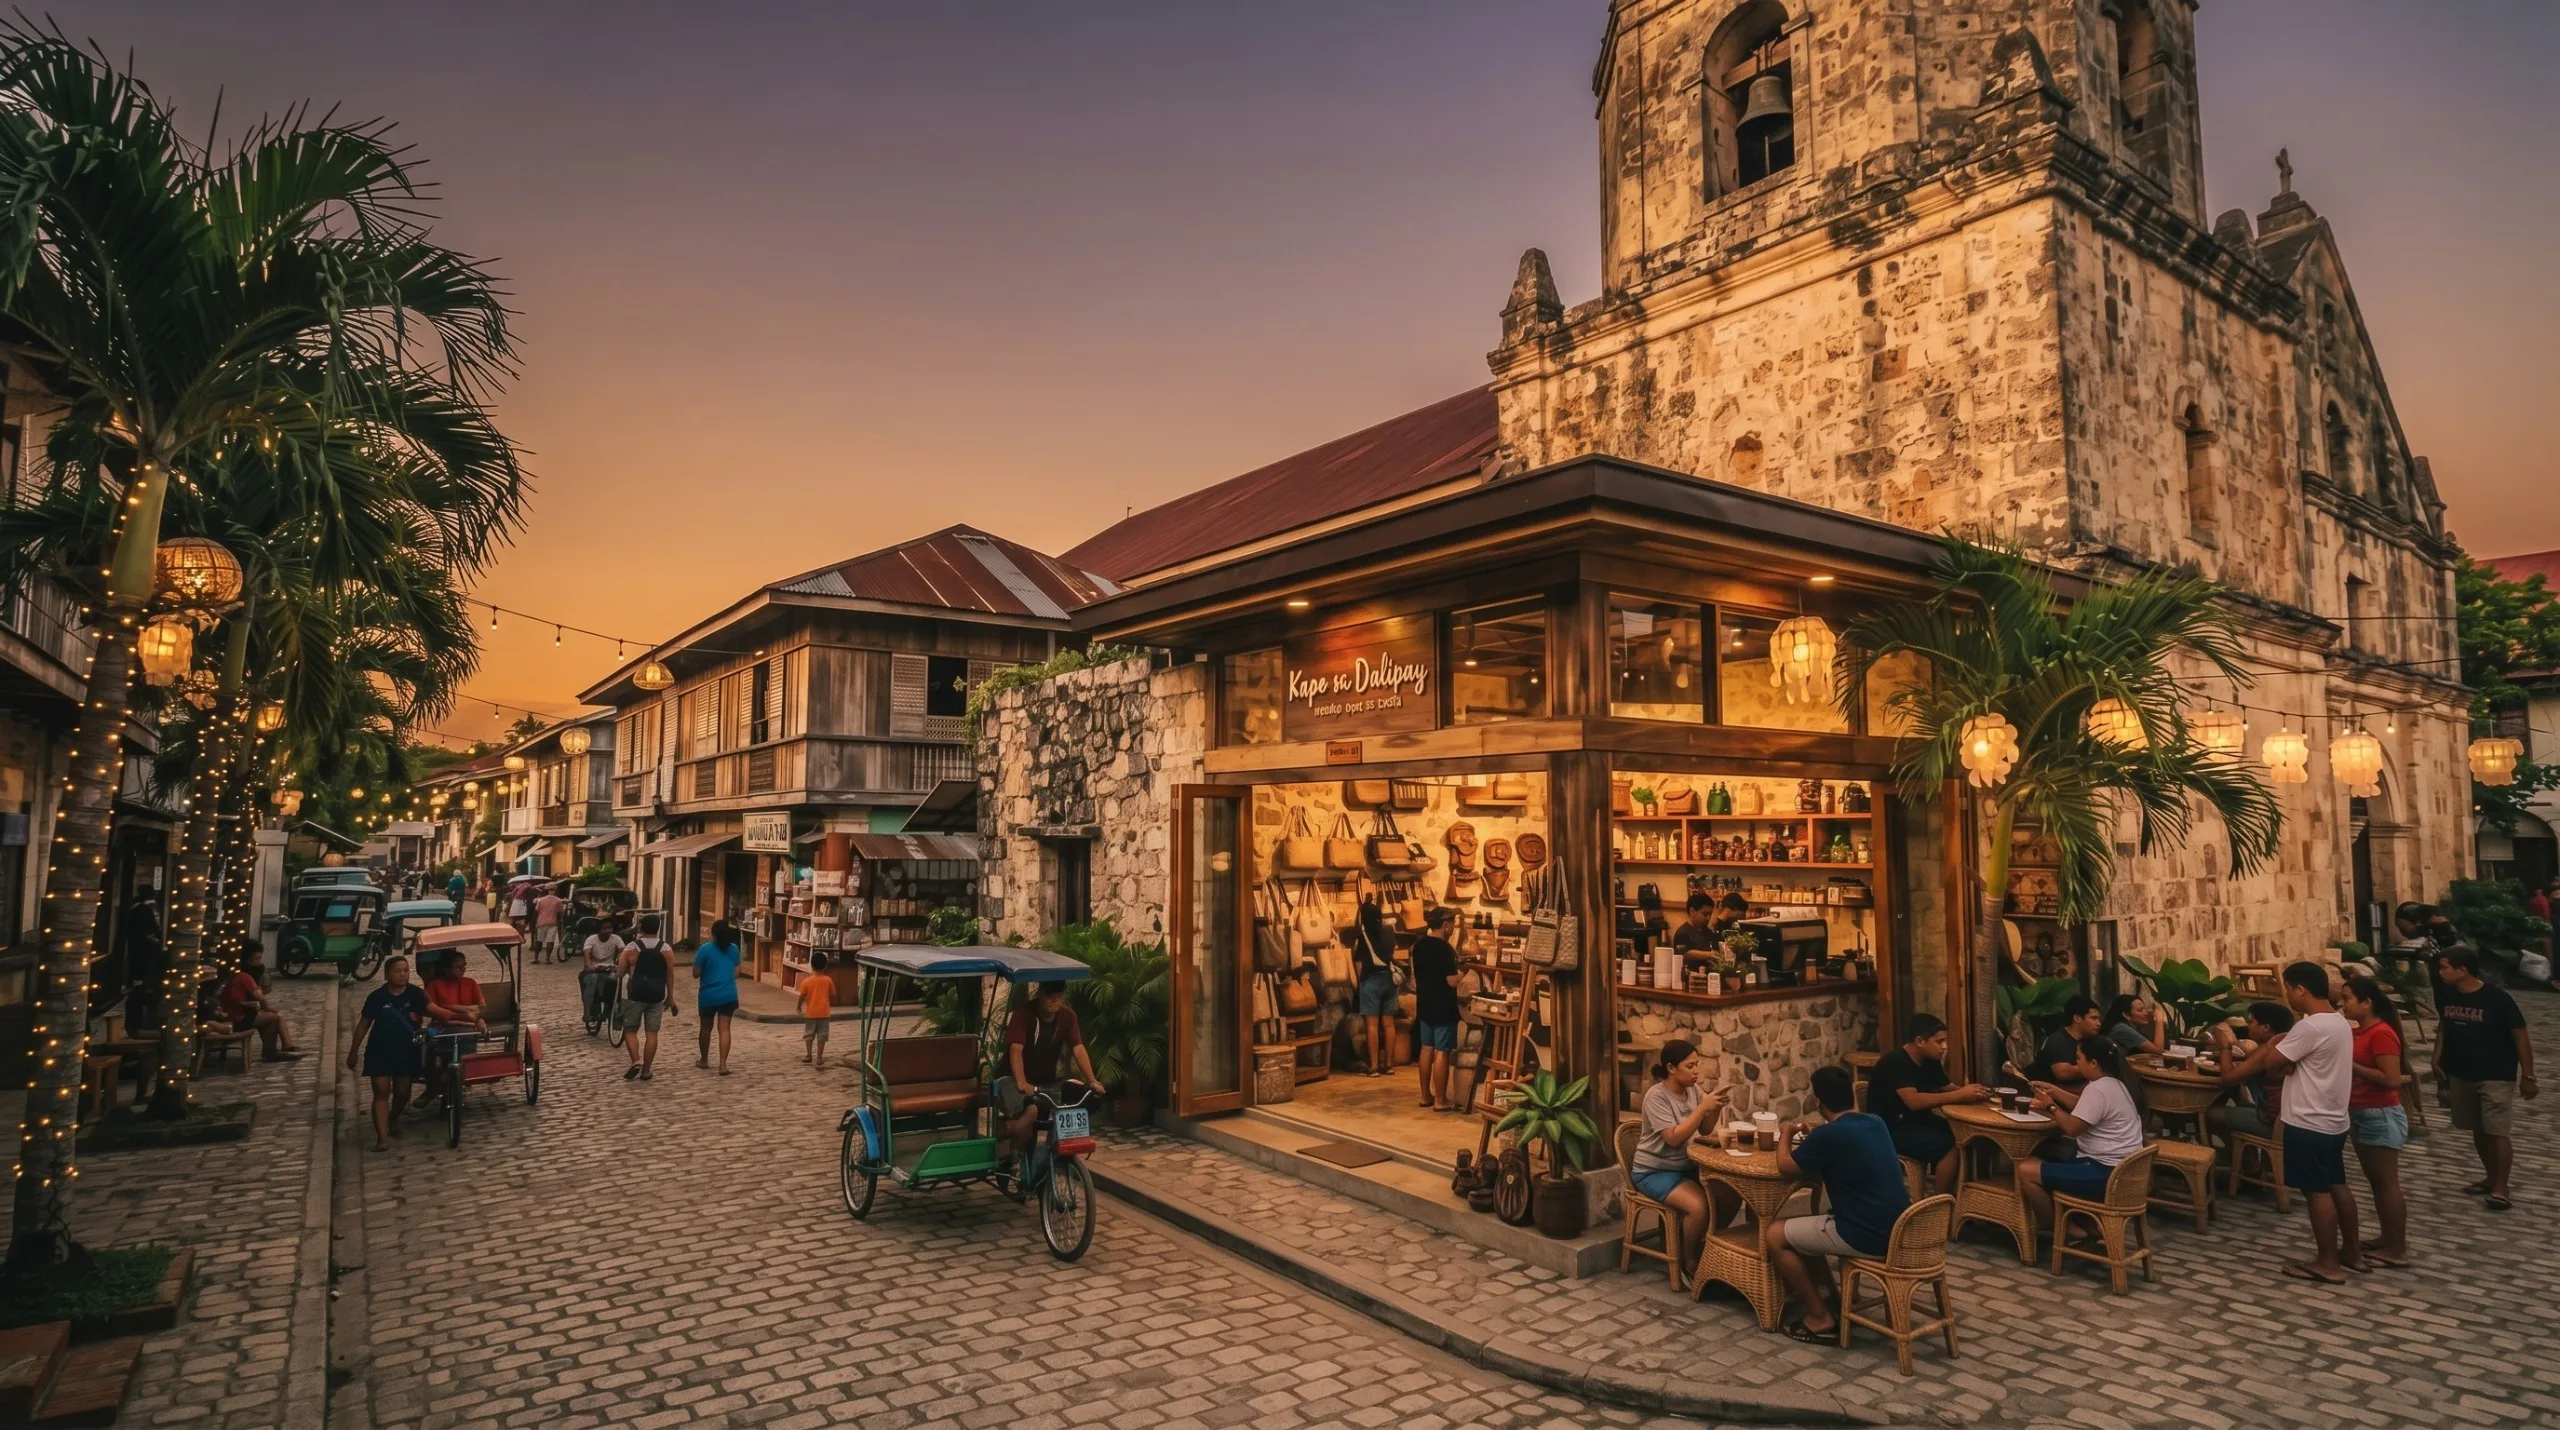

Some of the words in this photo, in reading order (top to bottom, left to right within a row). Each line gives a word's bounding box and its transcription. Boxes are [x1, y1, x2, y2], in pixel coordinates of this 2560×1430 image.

[1289, 669, 1328, 708] Kape
[1333, 673, 1352, 693] sa
[1355, 651, 1428, 695] Dalipay
